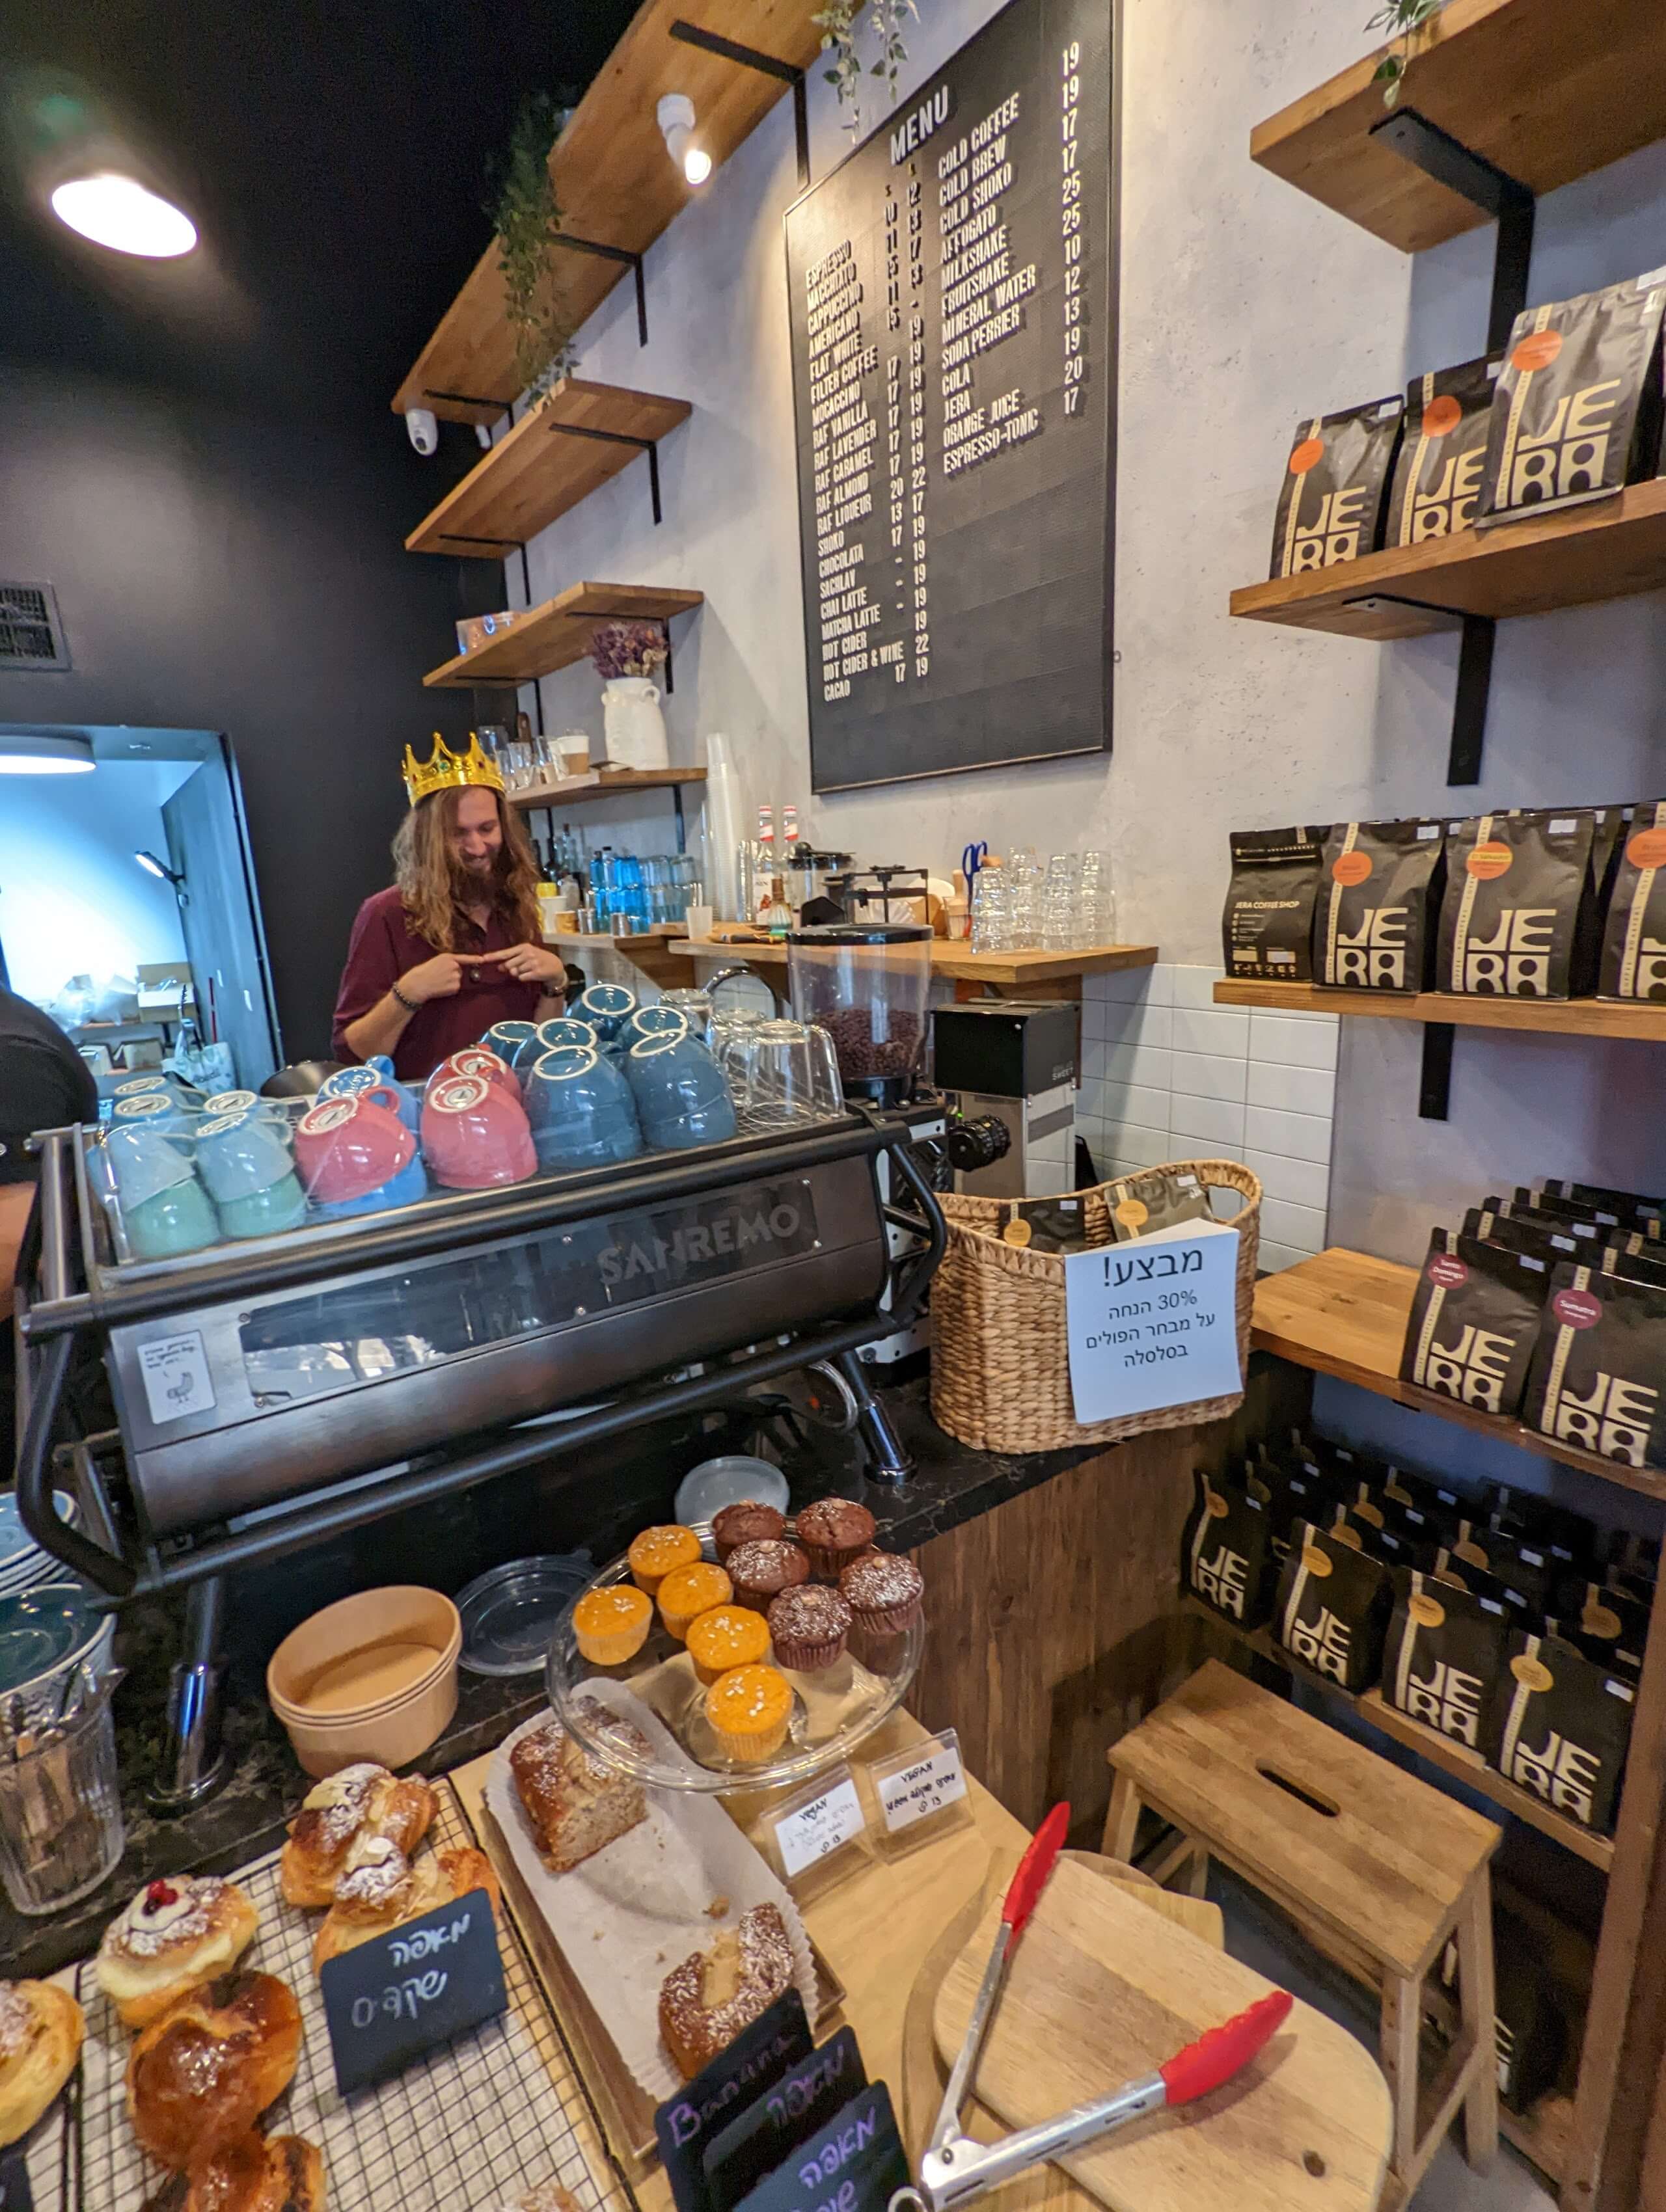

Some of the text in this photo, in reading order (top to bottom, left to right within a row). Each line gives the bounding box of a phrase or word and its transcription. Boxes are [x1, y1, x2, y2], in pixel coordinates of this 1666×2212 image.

[890, 84, 948, 166] MENU
[938, 42, 1079, 179] COLD COFFEE 19
[939, 75, 1079, 207] COLD BREW 19
[940, 108, 1077, 235] COLD SHOKO 17
[940, 140, 1077, 264] AFFOGATO 17
[806, 239, 851, 289] ESPRESSO
[941, 170, 1080, 291] MILKSHAKE 25
[942, 202, 1080, 317] FRUITSHAKE 25
[808, 282, 862, 335] CAPPUCCINO
[942, 235, 1080, 344] MINERAL WATER 10
[942, 266, 1080, 370] SODA PERRIER 12
[809, 310, 859, 359] AMERICANO
[810, 352, 830, 382] FLAT
[833, 330, 860, 365] WHITE
[811, 315, 922, 405] FILTER COFFEE 19
[942, 296, 1080, 396] COLA 13
[812, 341, 921, 427] MOCACCINO 17 19
[813, 366, 922, 450] RAF VANILLA 17 19
[944, 327, 1080, 423] JERA 19
[944, 356, 1083, 448] ORANGE JUICE 20
[814, 392, 922, 471] RAF LAVENDER 17 19
[815, 416, 923, 493] RAF CARAMEL 17 19
[944, 386, 1079, 474] ESPRESSO-TONIC 17
[816, 442, 923, 515] RAF ALMOND 17 19
[817, 466, 926, 536] RAF LIQUEUR 20 22
[818, 491, 923, 557] SHOKO 13 17
[819, 515, 925, 578] CHOCOLATA 17 19
[819, 539, 925, 599] SACHLAV 19
[821, 563, 926, 620] CHAI LATTE 19
[821, 586, 927, 641] MATCHA LATTE 19
[822, 610, 927, 662] HOT CIDER 19
[823, 633, 929, 682] HOT CIDER & WINE 22
[824, 656, 928, 702] CACAO 17 19
[597, 1204, 800, 1285] SANREMO
[1104, 1248, 1203, 1287] מבצע!
[1086, 1312, 1215, 1349] על מבחר הפולים
[1109, 1289, 1198, 1319] 30% הנחה
[1124, 1344, 1188, 1368] בסלסלה
[901, 1761, 933, 1783] VEGAN
